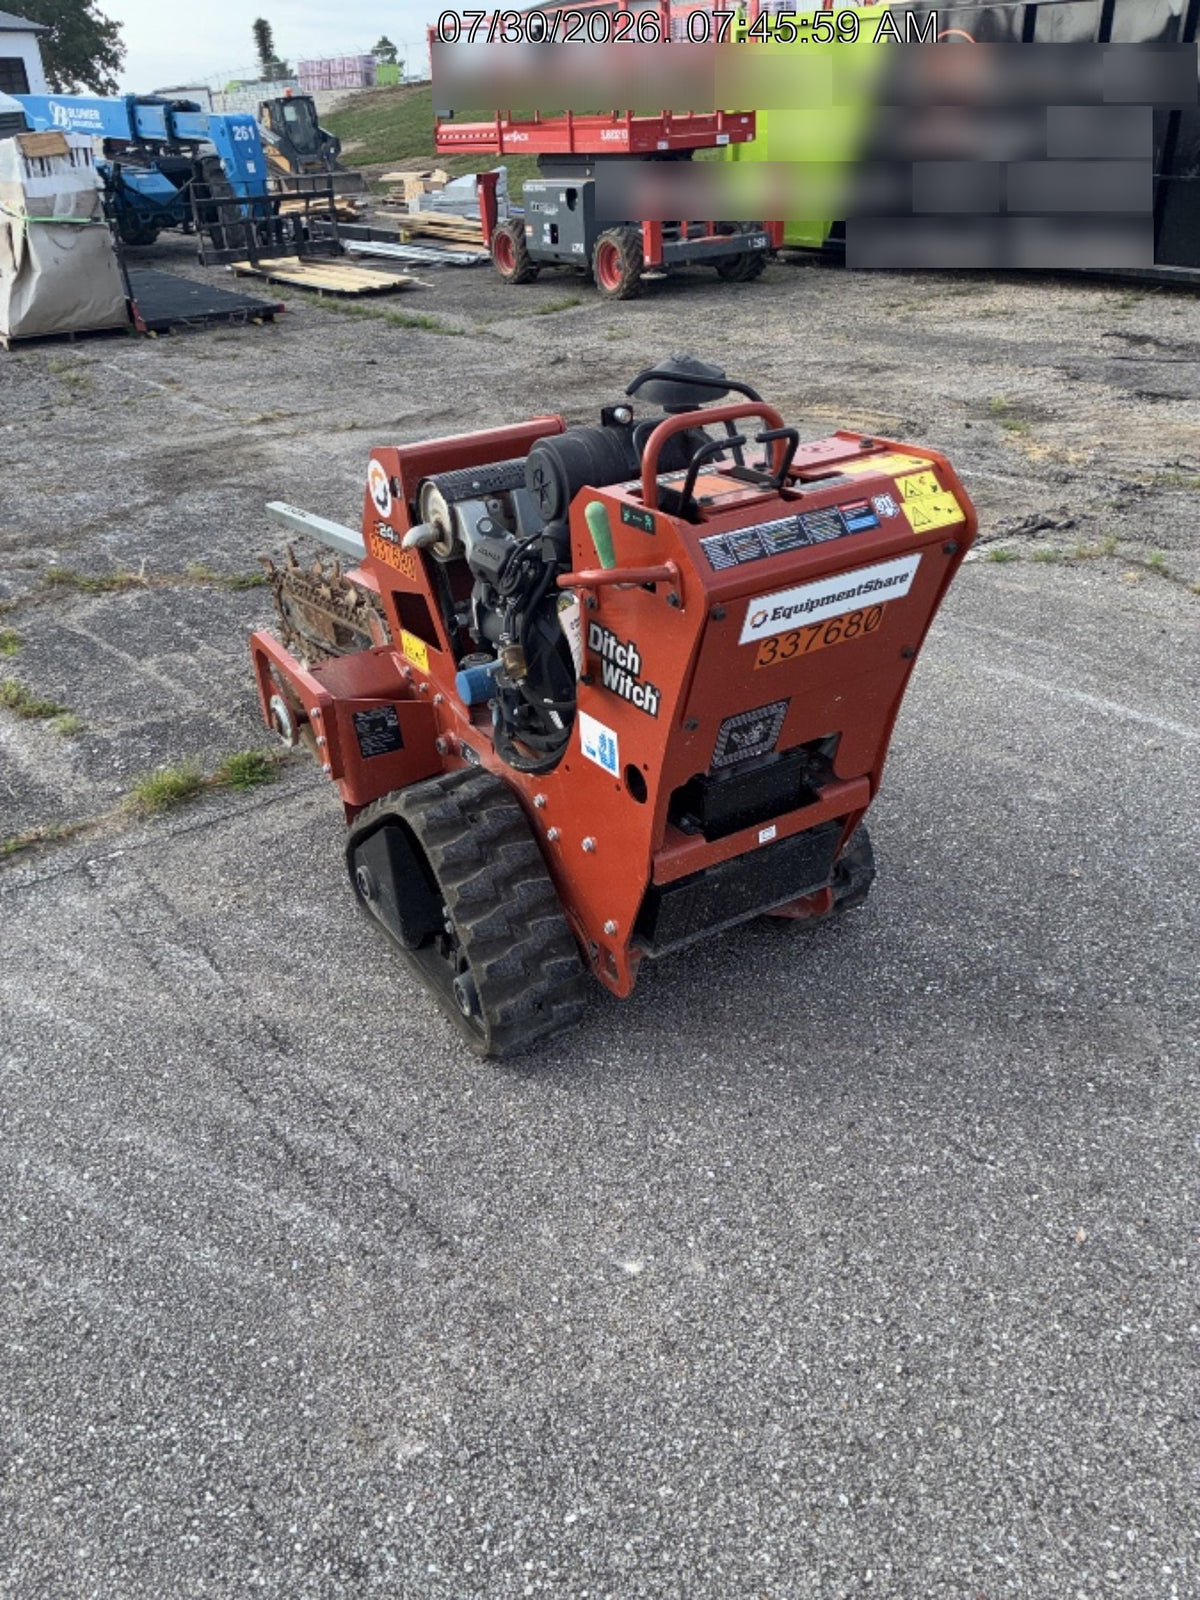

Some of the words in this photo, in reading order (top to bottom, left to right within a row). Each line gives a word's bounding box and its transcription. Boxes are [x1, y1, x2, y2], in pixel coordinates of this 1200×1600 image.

[232, 126, 255, 141] 261
[769, 572, 909, 622] EquipmentShare
[588, 622, 641, 677] Ditch
[759, 604, 884, 667] 337680
[601, 658, 659, 716] Witch
